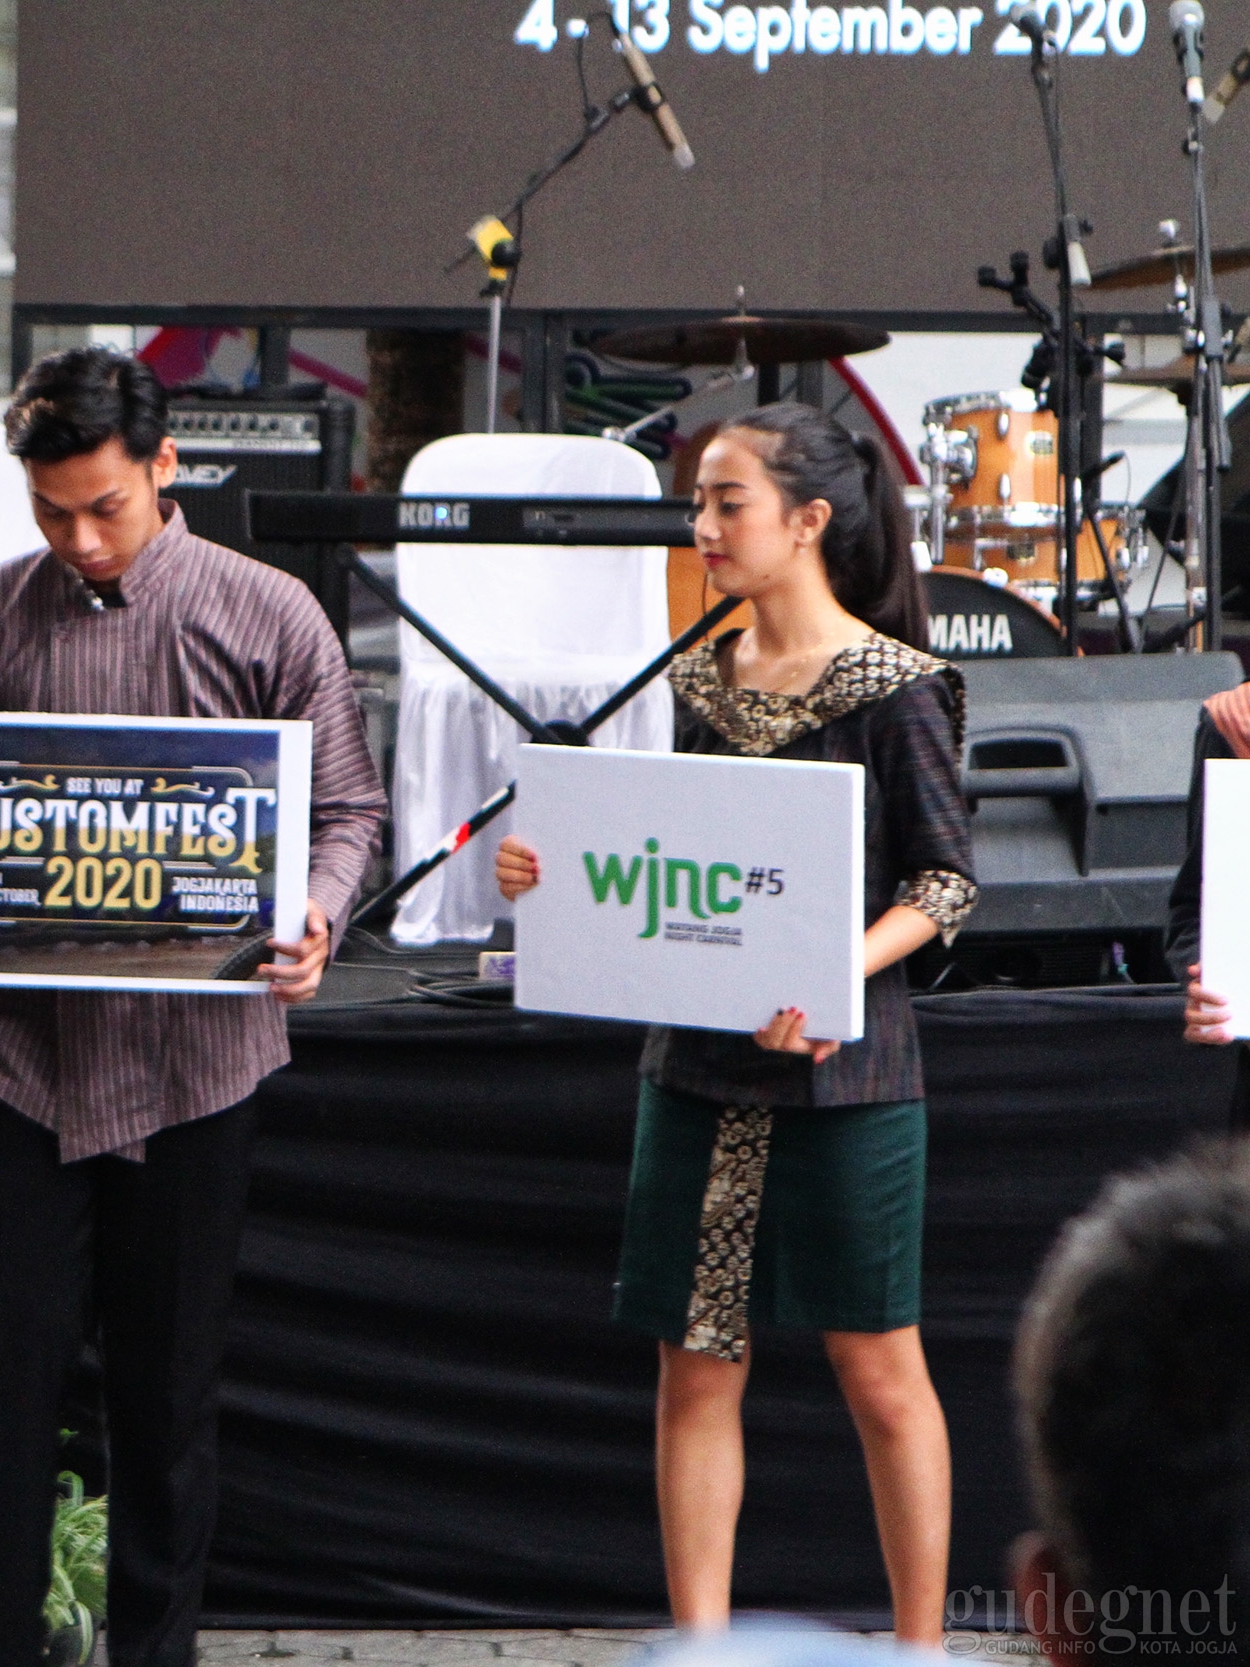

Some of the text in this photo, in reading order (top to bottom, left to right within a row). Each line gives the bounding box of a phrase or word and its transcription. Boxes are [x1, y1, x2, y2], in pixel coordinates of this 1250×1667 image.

[515, 0, 558, 52] 4
[687, 0, 984, 72] September
[993, 0, 1147, 56] 2020
[398, 502, 470, 529] KORG
[927, 614, 1013, 654] MAHA
[66, 777, 144, 797] SEE YOU AT
[44, 856, 163, 909] 2020
[172, 876, 257, 896] JOGJAKARTA
[583, 837, 785, 939] wjnc #5
[179, 894, 259, 913] INDONESIA
